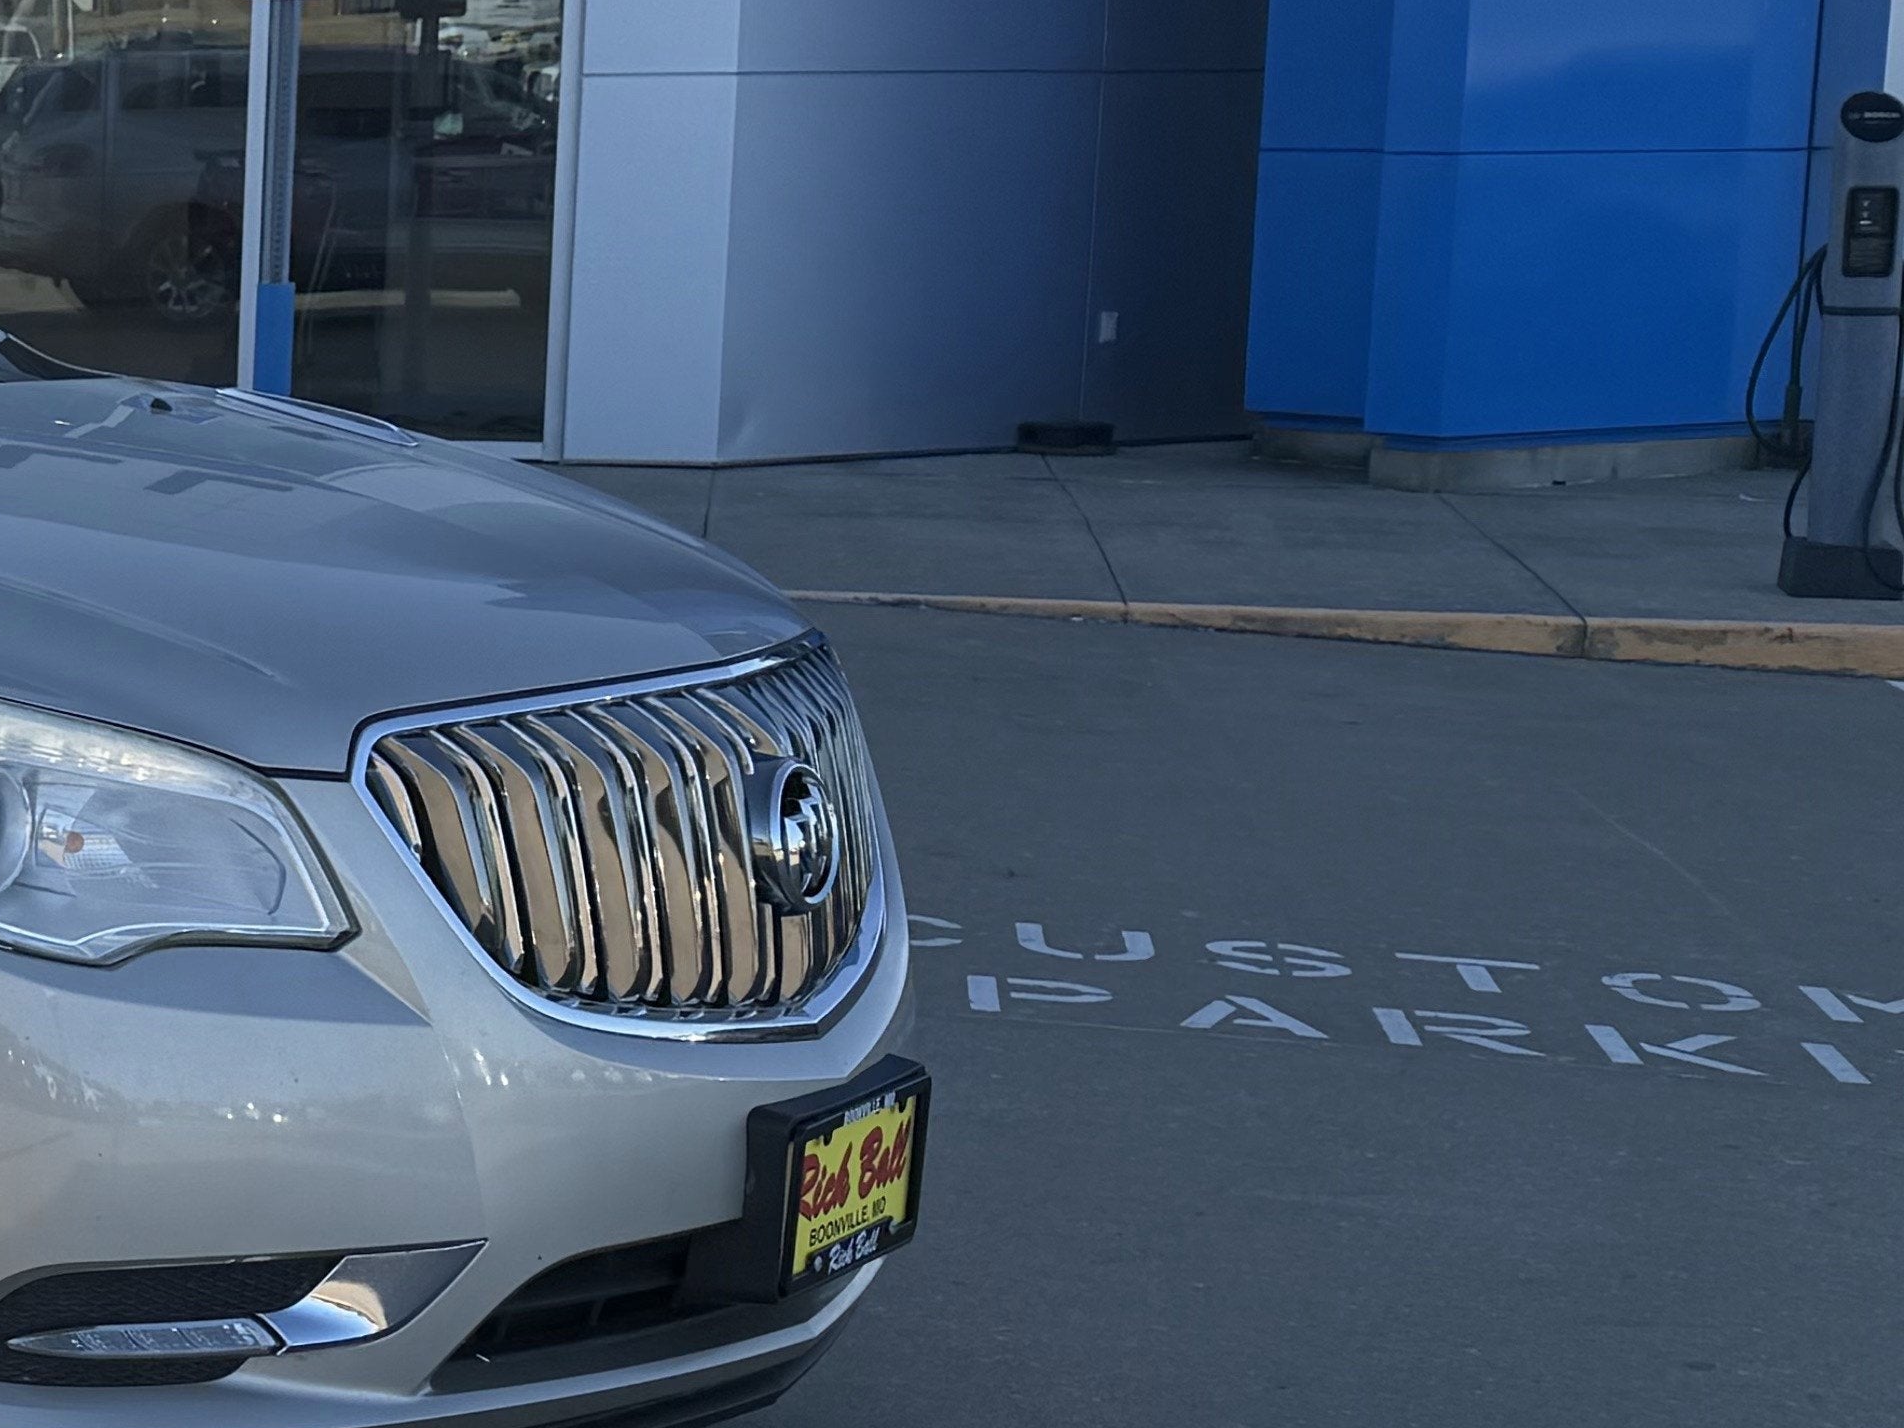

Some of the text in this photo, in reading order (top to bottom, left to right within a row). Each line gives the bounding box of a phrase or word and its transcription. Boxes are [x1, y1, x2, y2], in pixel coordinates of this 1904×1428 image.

[967, 974, 1904, 1085] PARKI
[798, 1115, 912, 1222] Rick Ball
[828, 1226, 881, 1274] Rick Ball
